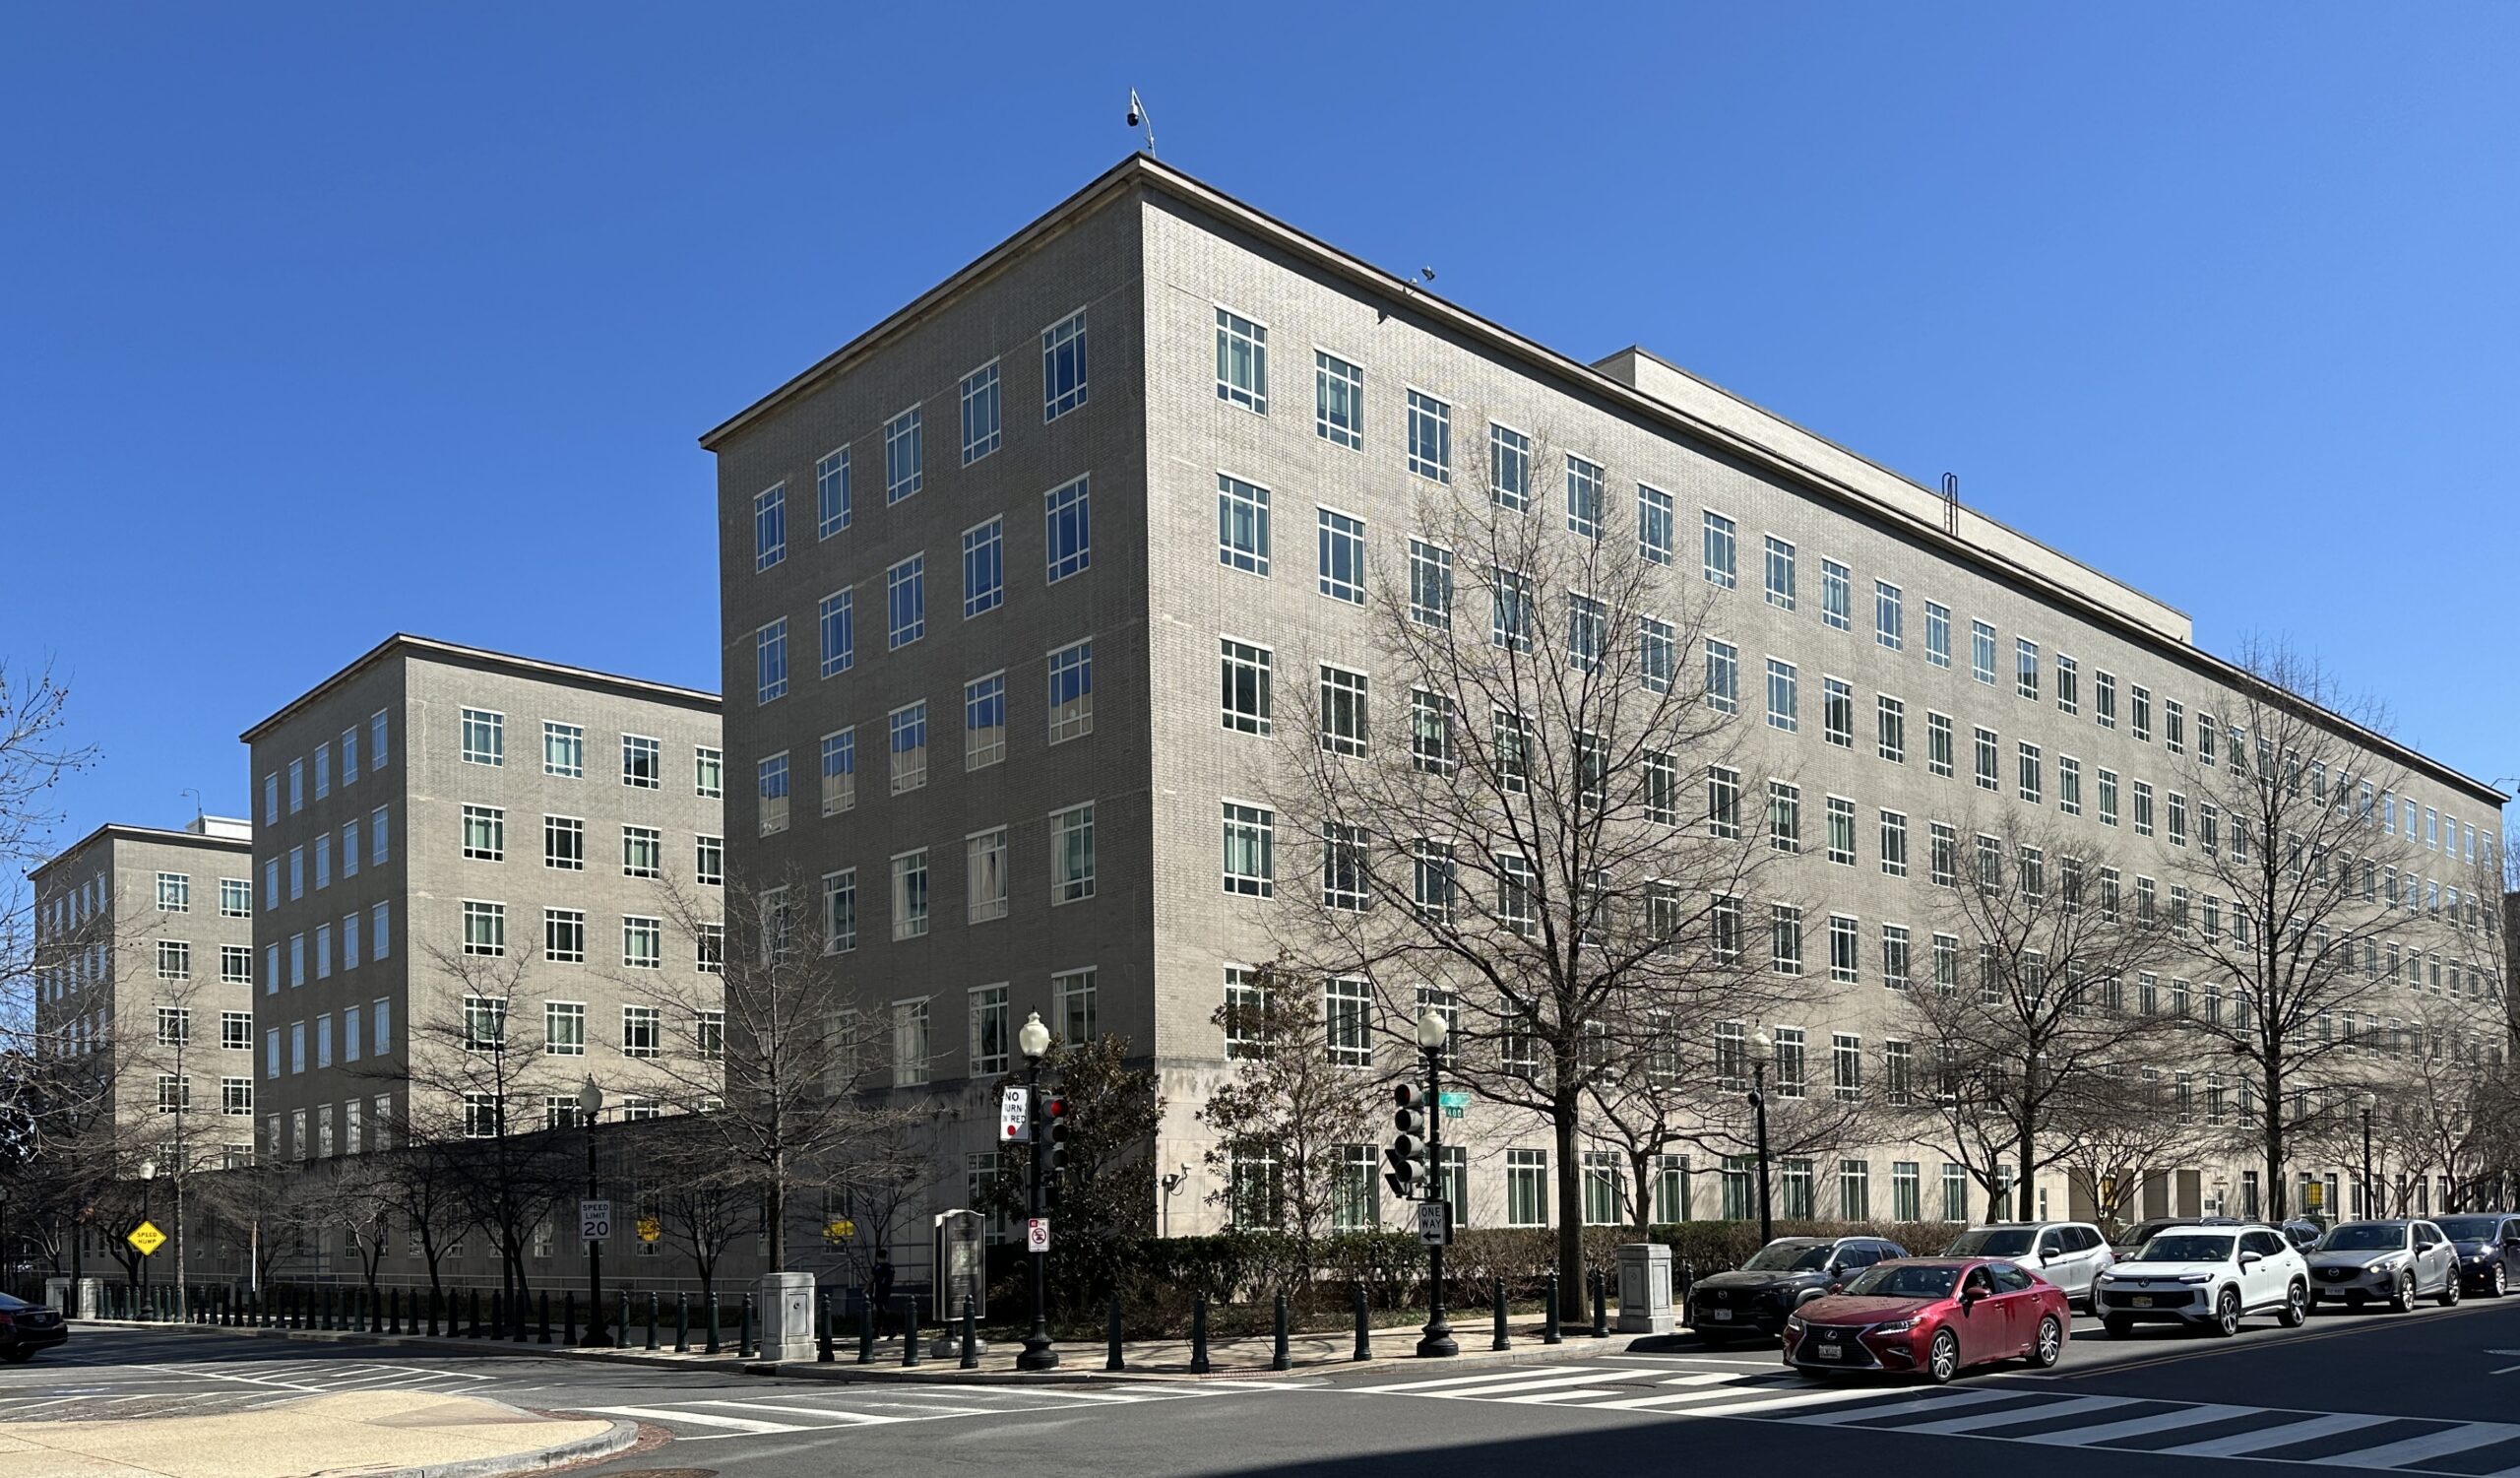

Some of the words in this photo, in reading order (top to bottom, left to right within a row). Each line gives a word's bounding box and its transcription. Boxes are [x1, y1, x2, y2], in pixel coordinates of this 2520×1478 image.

[1005, 1091, 1019, 1102] NO
[1010, 1115, 1026, 1124] RED
[1421, 1206, 1440, 1217] ONE
[584, 1221, 608, 1236] 20
[1421, 1218, 1441, 1229] WAY
